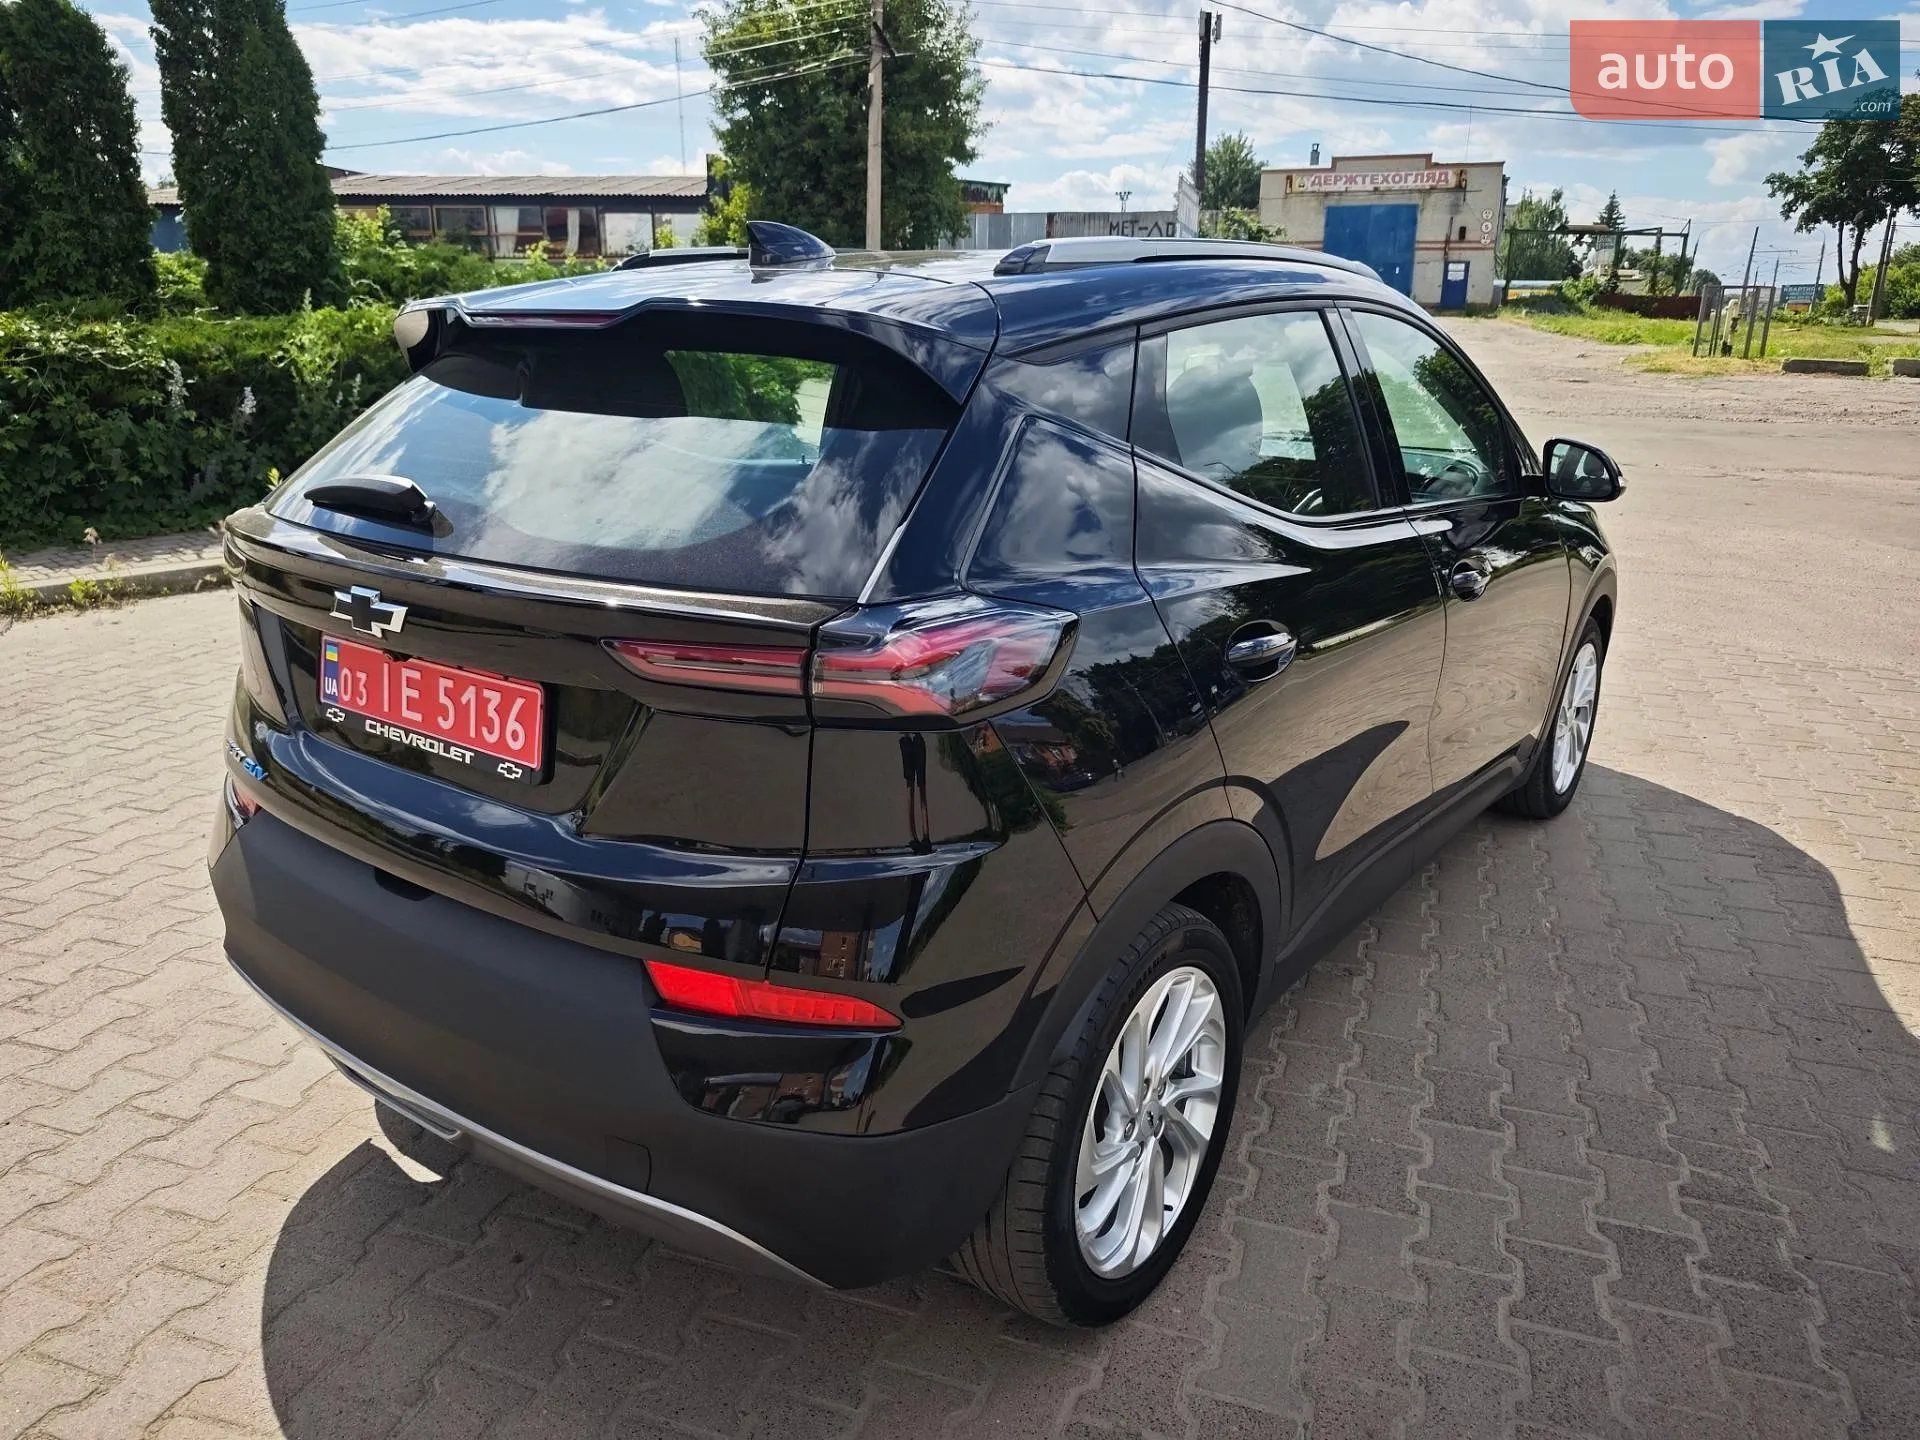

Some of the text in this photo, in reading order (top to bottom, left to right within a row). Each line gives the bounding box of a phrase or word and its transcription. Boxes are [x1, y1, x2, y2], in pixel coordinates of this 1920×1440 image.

[1310, 169, 1450, 187] ДЕРЖТЕХОГЛЯД
[325, 662, 526, 751] UA 03 IE 5136
[365, 719, 475, 765] CHEVROLET
